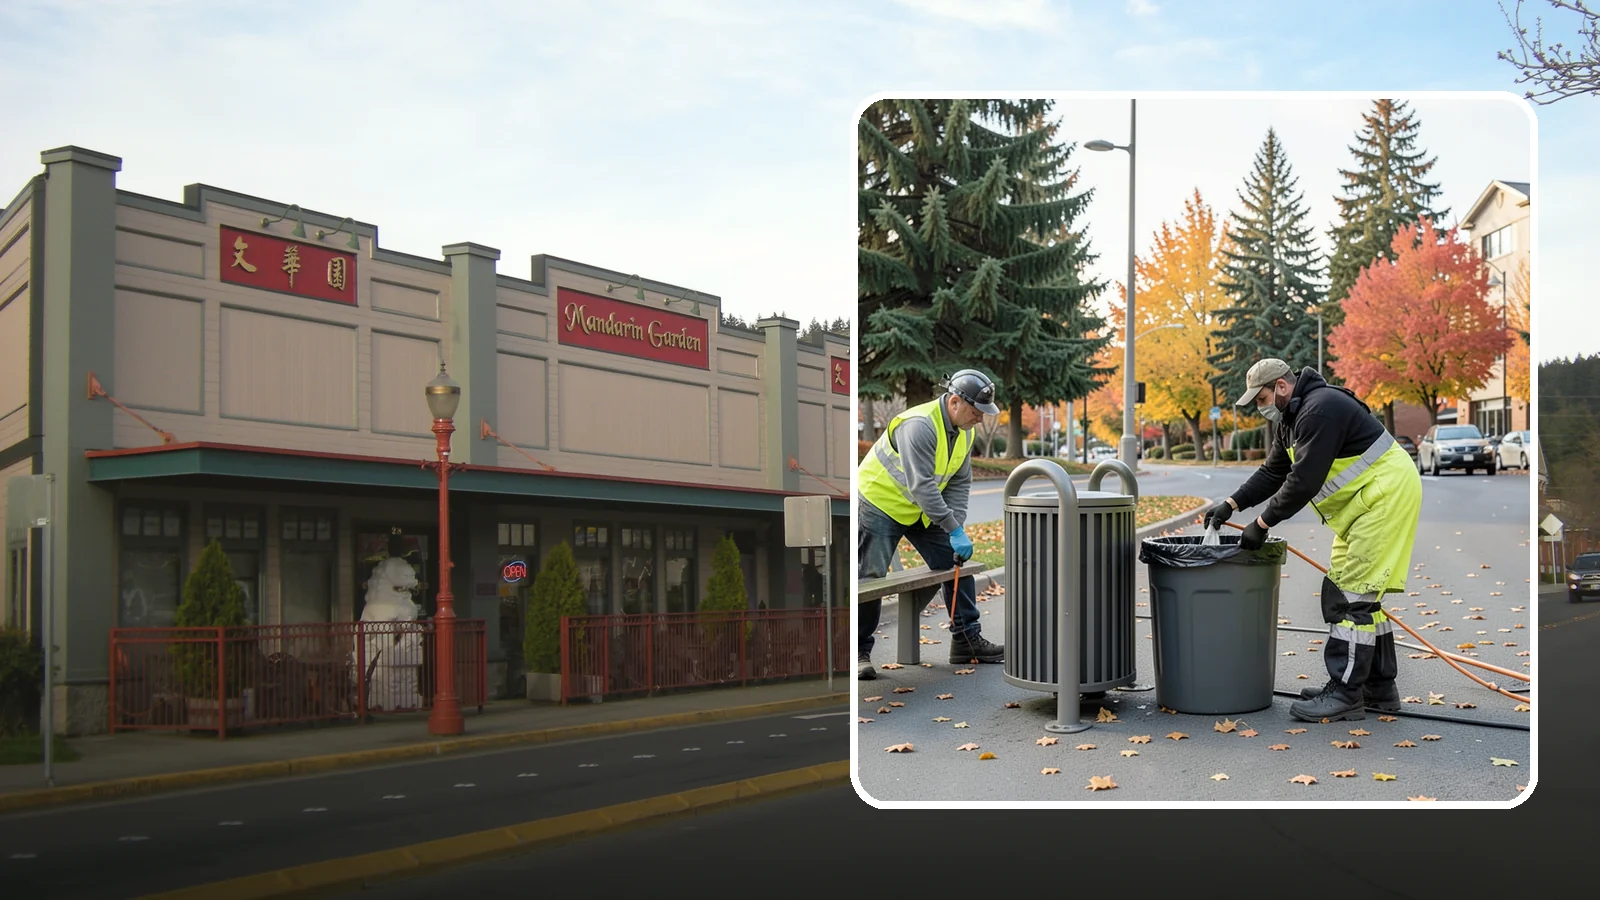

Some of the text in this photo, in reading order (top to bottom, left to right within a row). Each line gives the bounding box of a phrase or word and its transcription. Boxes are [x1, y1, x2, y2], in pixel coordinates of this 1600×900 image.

[231, 235, 346, 291] 文華園
[564, 302, 701, 352] Mandarin Garden
[503, 565, 527, 578] OPEN
